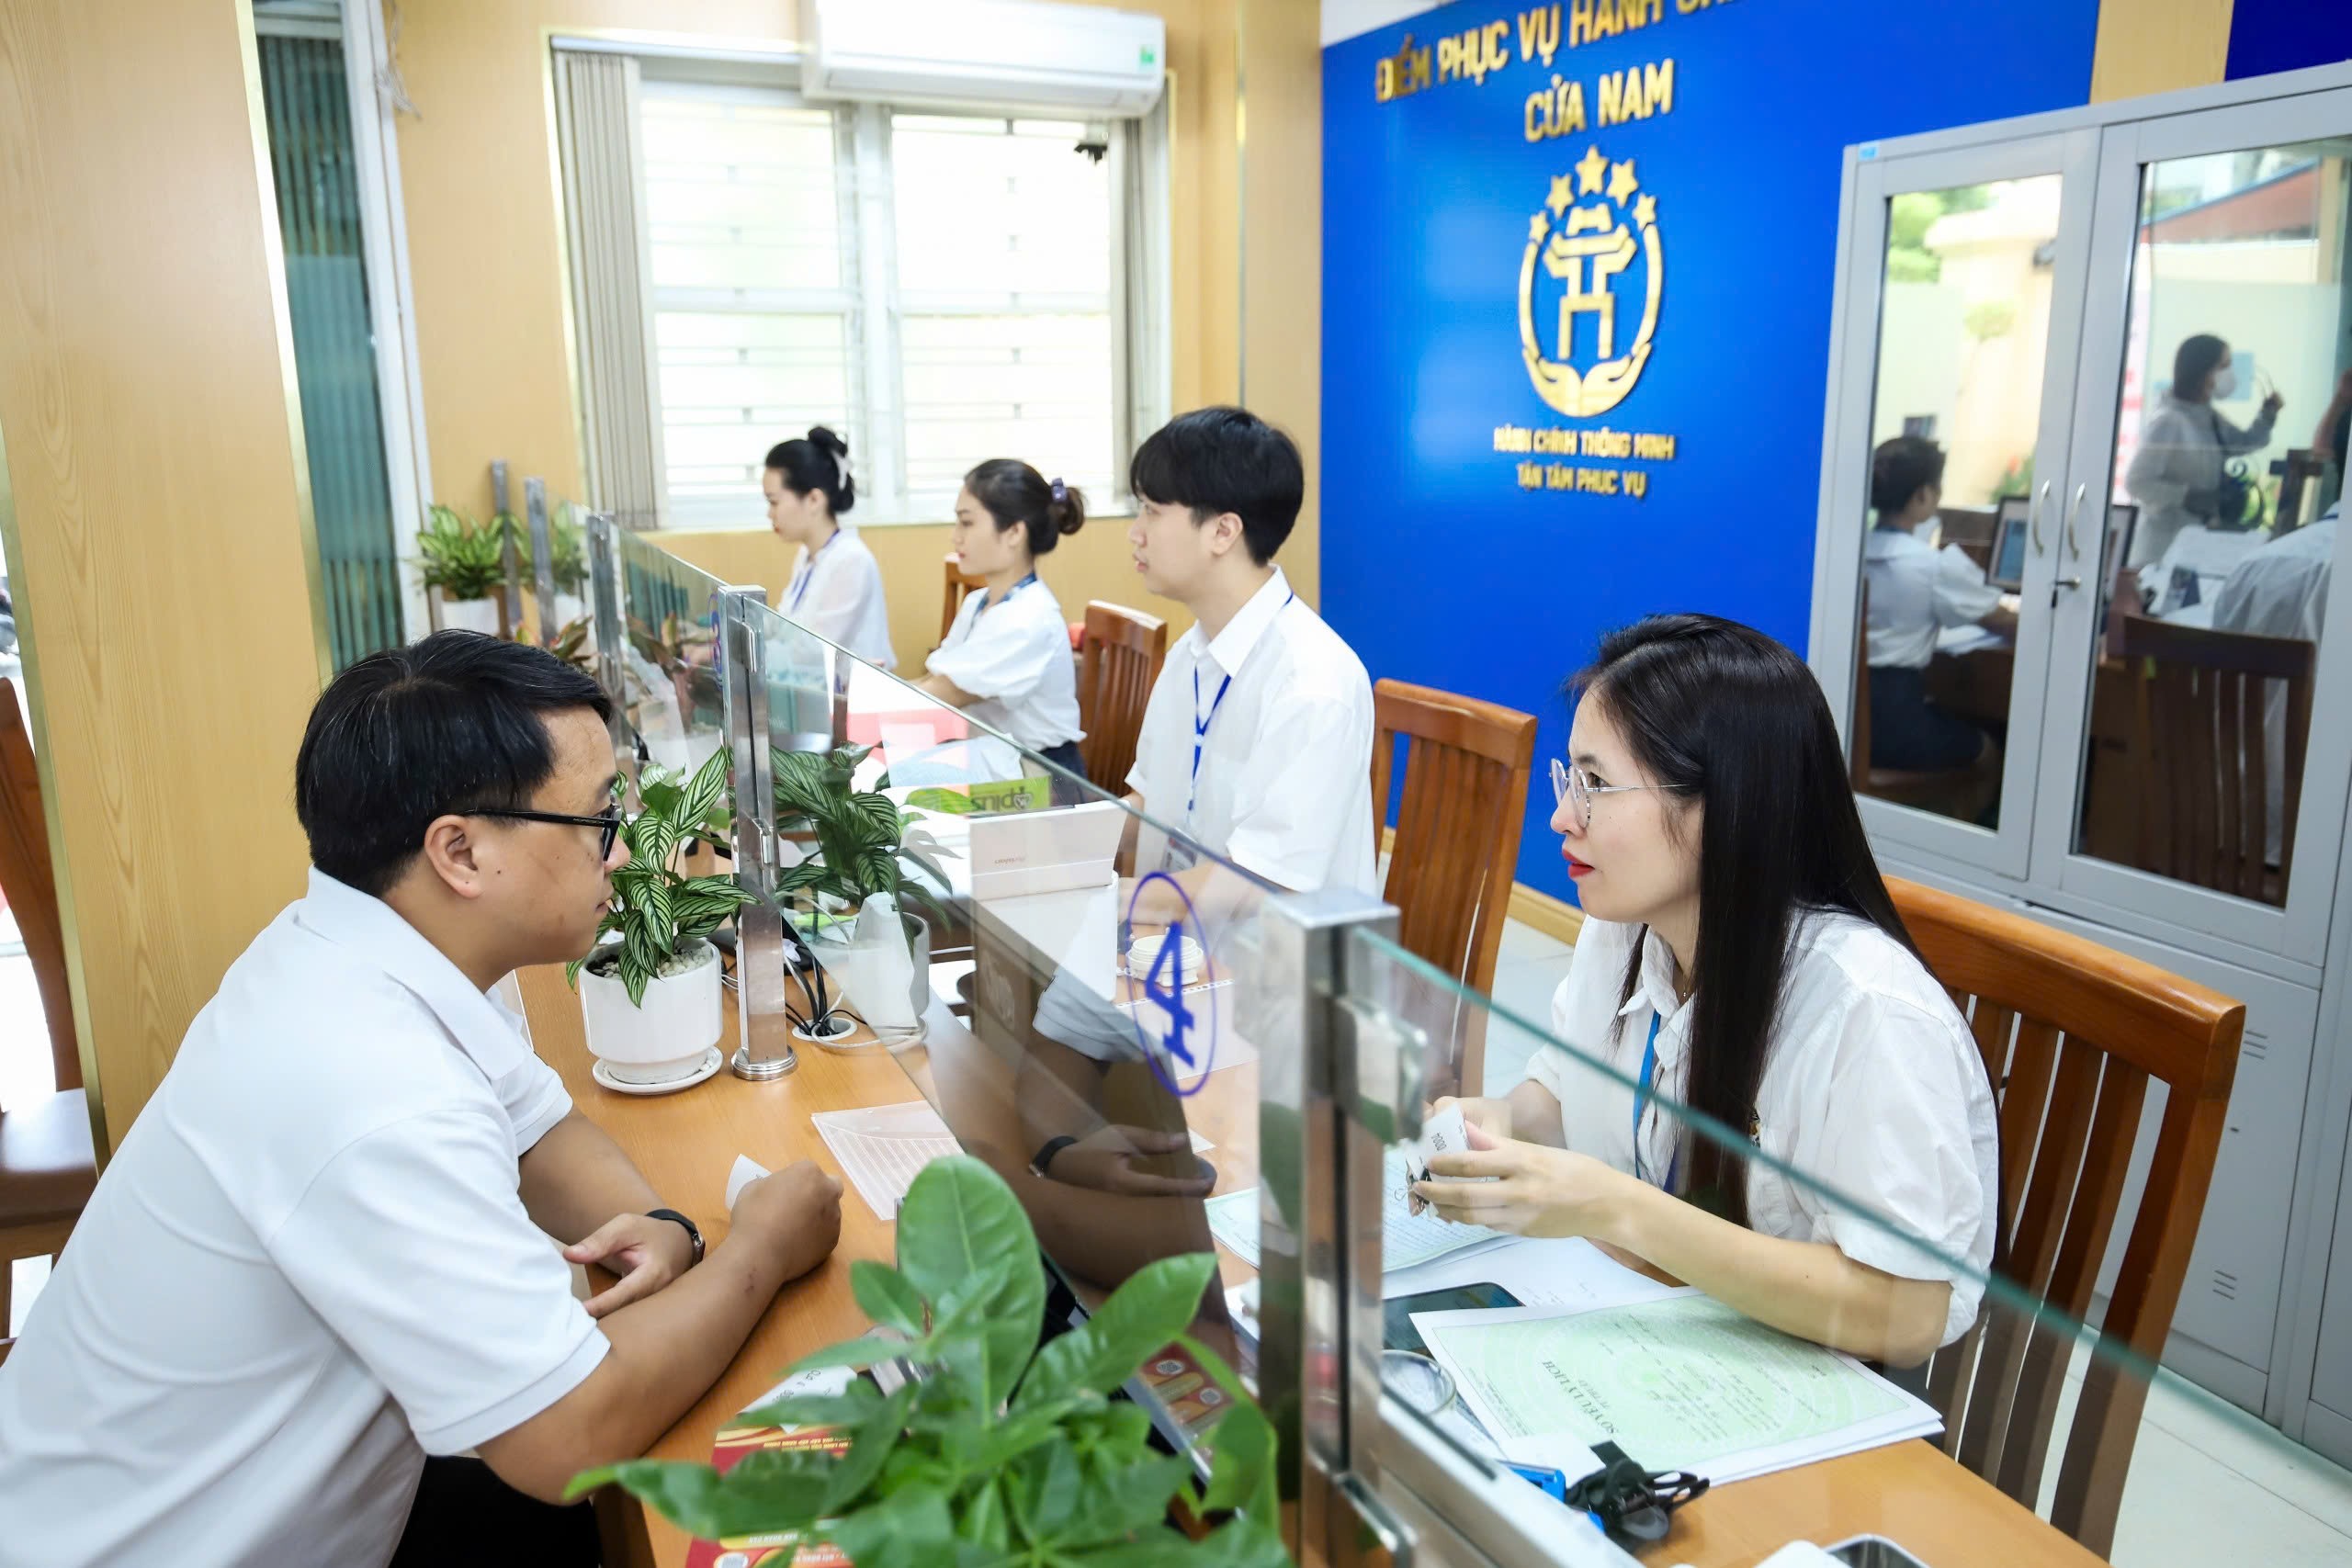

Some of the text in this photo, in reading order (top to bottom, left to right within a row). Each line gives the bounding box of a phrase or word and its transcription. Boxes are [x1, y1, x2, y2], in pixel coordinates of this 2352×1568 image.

[1438, 20, 1509, 85] PHỤC
[1518, 4, 1560, 67] VỤ
[1525, 58, 1674, 142] CỬA NAM
[1145, 921, 1194, 1069] 4
